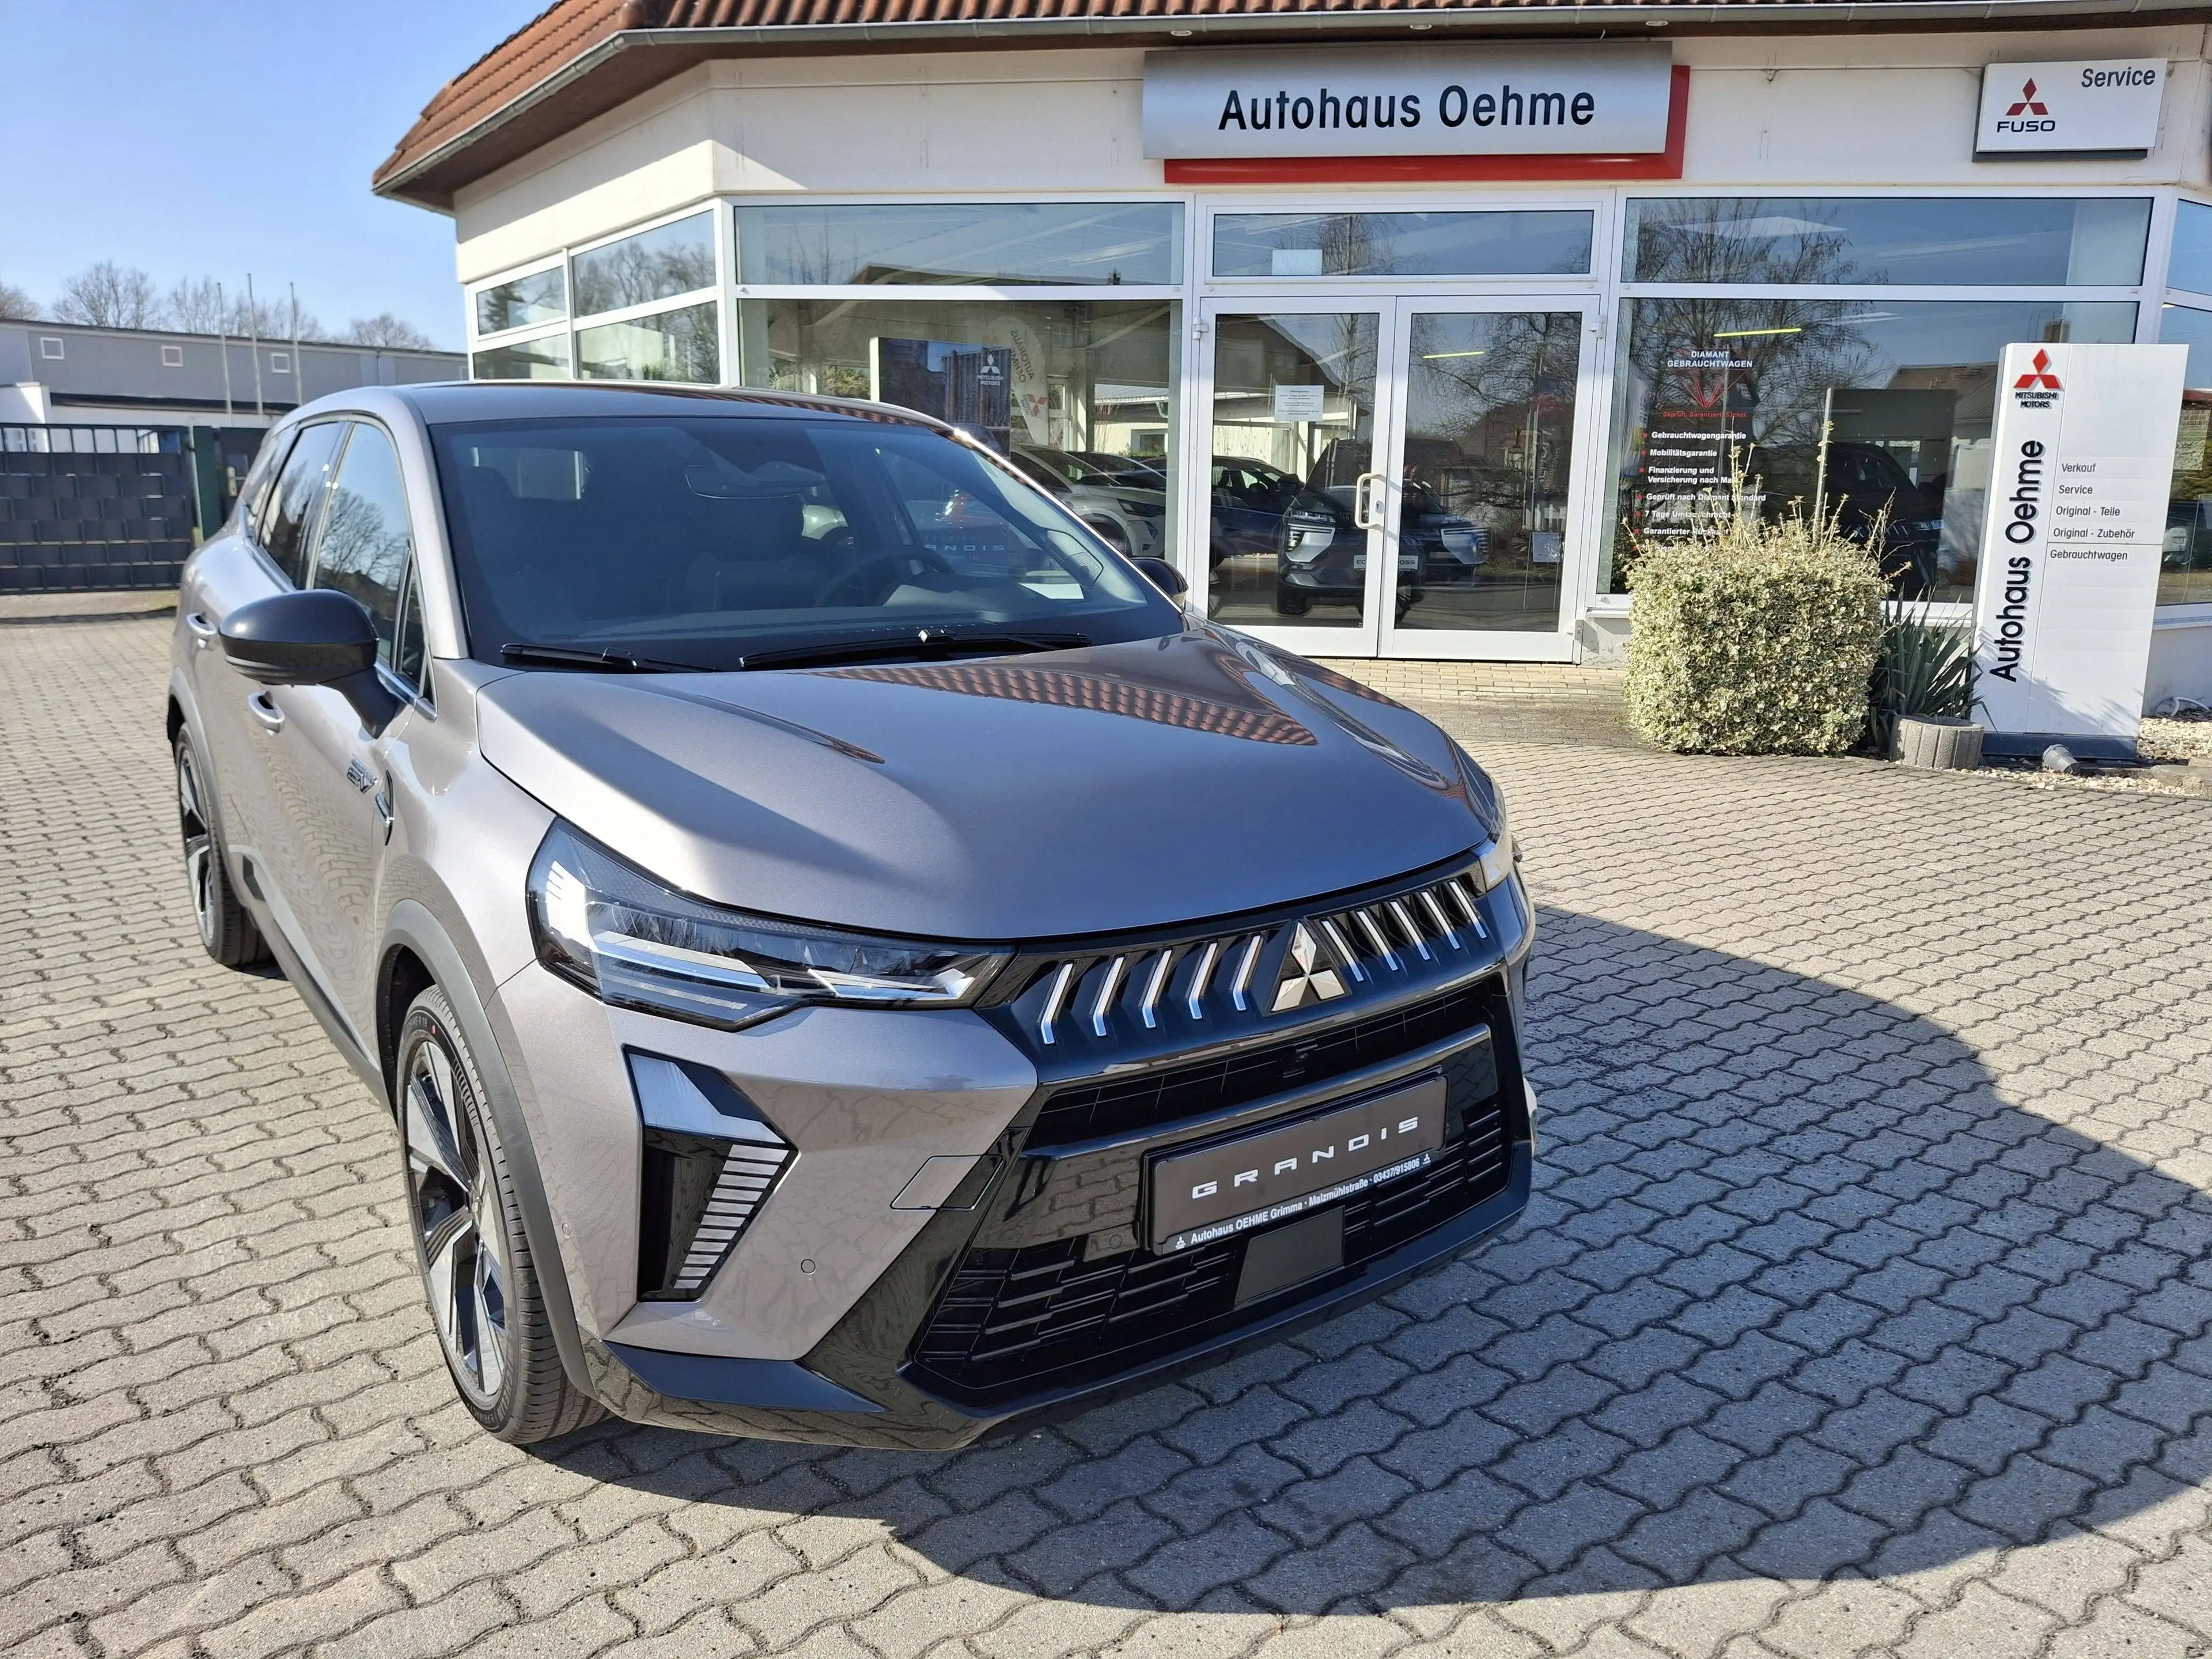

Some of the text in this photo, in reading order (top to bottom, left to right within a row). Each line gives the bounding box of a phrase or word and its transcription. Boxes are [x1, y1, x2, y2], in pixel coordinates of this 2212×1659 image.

[2081, 66, 2156, 88] Service
[1218, 85, 1595, 130] Autohaus Oehme
[1997, 120, 2056, 133] FUSO
[2015, 392, 2057, 400] MITSUBISHI
[1651, 431, 1747, 441] Gebrauchtwagengarantie
[1650, 449, 1718, 458] Mobilitätsgarantie
[1648, 467, 1698, 475] Finanzierung
[2062, 463, 2096, 473] Verkauf
[1648, 476, 1698, 484] Versicherung
[2059, 485, 2093, 494] Service
[1646, 493, 1676, 501] Geprüft
[1652, 511, 1670, 519] Tage
[2056, 506, 2091, 517] Original
[2100, 507, 2120, 516] Teile
[2053, 528, 2088, 539] Original
[2097, 528, 2135, 538] Zubehör
[2050, 550, 2128, 560] Gebrauchtwagen
[1990, 440, 2044, 683] Autohaus Oehme
[1192, 1116, 1418, 1199] GRANDIS
[1191, 1225, 1234, 1244] Autohaus
[1236, 1211, 1268, 1230] OEHME
[1270, 1201, 1302, 1219] Grimma
[1309, 1178, 1369, 1207] Malzmühlstraße
[1373, 1158, 1421, 1183] 03437/915806
